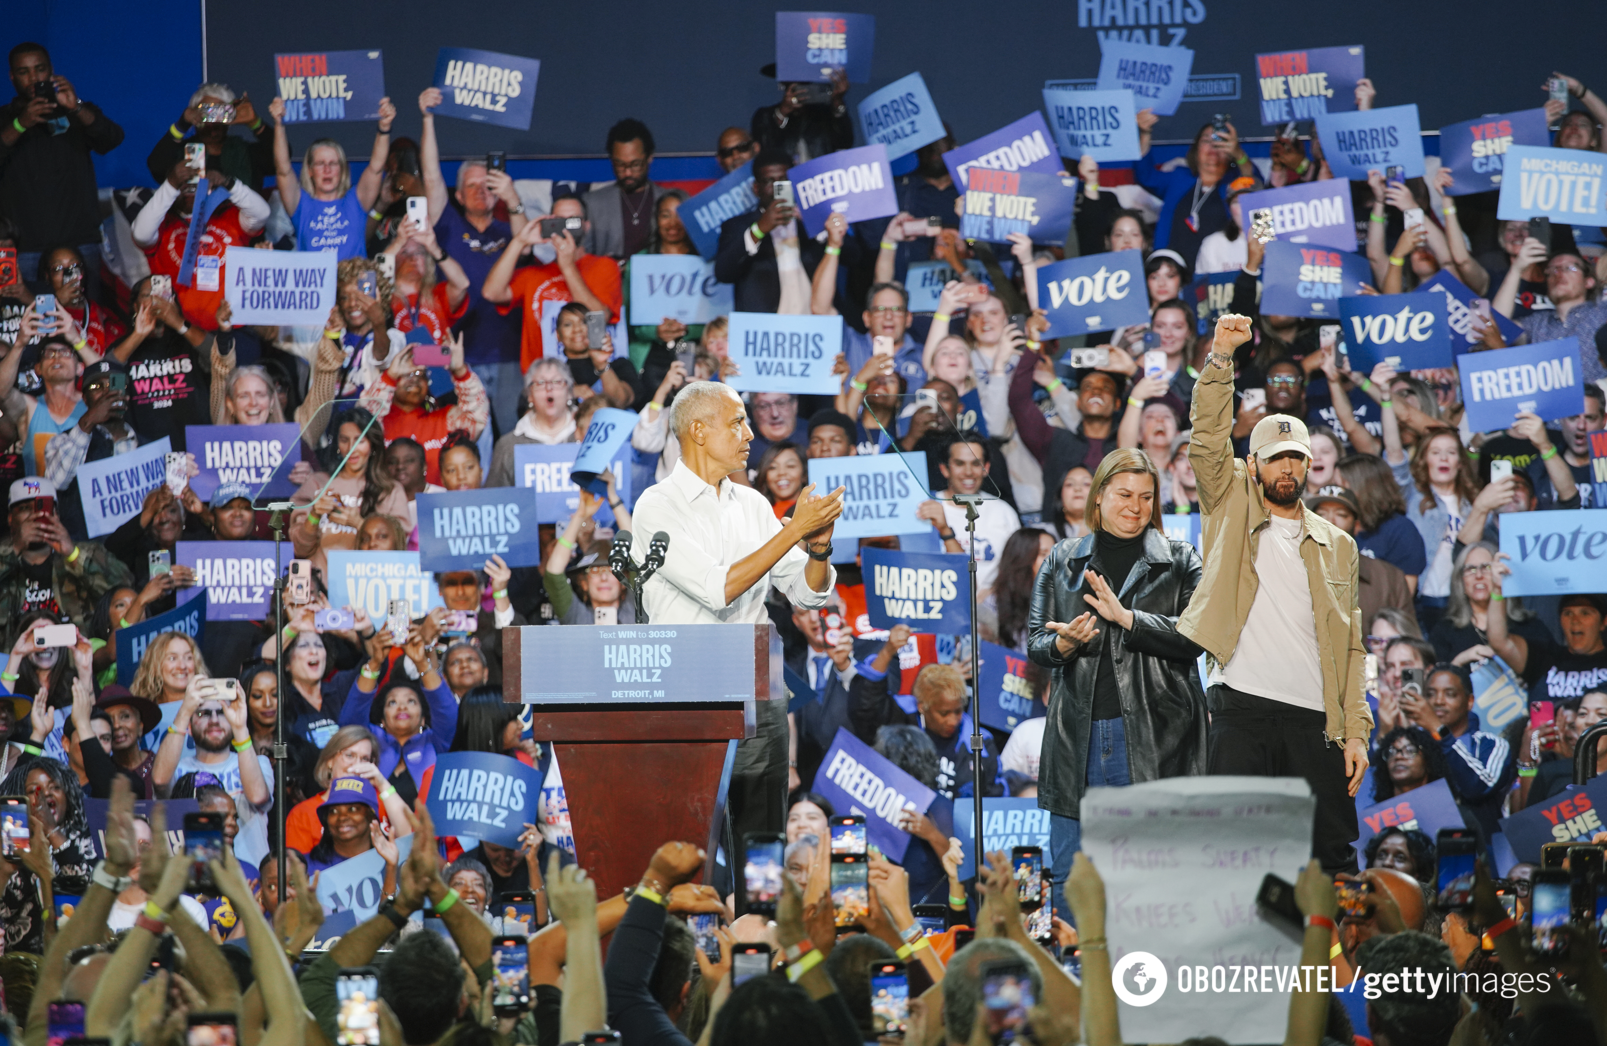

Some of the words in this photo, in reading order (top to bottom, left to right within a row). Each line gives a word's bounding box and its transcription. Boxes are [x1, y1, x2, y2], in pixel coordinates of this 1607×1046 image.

[807, 18, 847, 34] YES
[1078, 0, 1206, 28] HARRIS
[807, 33, 847, 49] SHE
[277, 54, 328, 77] WHEN
[806, 48, 848, 64] CAN
[1257, 52, 1308, 78] WHEN
[444, 59, 523, 99] HARRIS
[1116, 58, 1174, 86] HARRIS
[278, 76, 307, 100] WE
[307, 74, 353, 101] VOTE,
[1123, 82, 1162, 99] WALZ
[1184, 80, 1236, 96] RESIDENT
[1259, 75, 1288, 101] WE
[1287, 72, 1334, 98] VOTE,
[283, 99, 308, 122] WE
[310, 97, 345, 120] WIN
[453, 88, 509, 113] WALZ
[1261, 99, 1291, 122] WE
[1291, 95, 1328, 120] WIN
[864, 92, 920, 137] HARRIS
[1055, 105, 1121, 131] HARRIS
[876, 120, 919, 145] WALZ
[1066, 133, 1112, 149] WALZ
[1335, 126, 1399, 154] HARRIS
[1469, 120, 1513, 140] YES
[956, 129, 1051, 186] FEEDOM
[1347, 151, 1393, 168] WALZ
[1472, 154, 1504, 174] CA
[1520, 157, 1603, 176] MICHIGAN
[796, 162, 885, 210] FREEDOM
[968, 167, 1021, 195] WHEN
[1520, 172, 1601, 214] VOTE!
[693, 176, 759, 233] HARRI
[965, 190, 993, 216] WE
[995, 193, 1041, 226] VOTE,
[1248, 195, 1345, 235] EEDOM
[963, 213, 991, 239] WE
[1300, 248, 1343, 267] YES
[235, 267, 249, 287] A
[252, 267, 289, 288] NEW
[292, 266, 327, 287] WAY
[646, 269, 719, 298] vote
[1047, 265, 1132, 310] vote
[1298, 264, 1343, 284] SHE
[241, 288, 320, 310] FORWARD
[1296, 281, 1343, 300] CAN
[1350, 305, 1435, 345] vote
[743, 330, 823, 361] HARRIS
[754, 361, 811, 378] WALZ
[1469, 356, 1575, 403] FREEDOM
[133, 373, 188, 395] WALZ
[582, 421, 616, 444] RIS
[205, 439, 283, 469] HARRIS
[91, 477, 104, 499] A
[105, 465, 141, 495] NEW
[217, 467, 273, 484] WALZ
[525, 461, 623, 492] FREEM
[826, 470, 910, 502] HARRIS
[100, 480, 166, 518] FORW
[1318, 485, 1346, 498] NY
[434, 503, 521, 538] HARRIS
[842, 503, 899, 521] WALZ
[447, 535, 510, 557] WALZ
[1516, 523, 1607, 562] vote
[196, 557, 276, 587] HARRIS
[874, 565, 958, 602] HARRIS
[207, 586, 265, 604] WALZ
[884, 597, 943, 621] WALZ
[132, 609, 199, 664] HRIS
[599, 630, 616, 639] Text
[617, 630, 637, 639] WIN
[648, 630, 677, 638] 30330
[604, 644, 672, 668] HARRIS
[1005, 655, 1028, 678] YE
[614, 669, 662, 683] WALZ
[1001, 672, 1035, 700] SHE
[611, 690, 652, 699] DETROIT,
[653, 690, 665, 698] MI
[998, 690, 1034, 718] CAN
[1547, 684, 1585, 698] WAL
[439, 769, 527, 812] HARRIS
[825, 748, 917, 831] FREEDOM
[446, 801, 509, 829] WALZ
[1363, 801, 1415, 834] YES
[1541, 792, 1593, 826] YES
[970, 808, 1051, 839] HARRI
[1551, 808, 1602, 843] SHE
[1213, 892, 1258, 928] WEA
